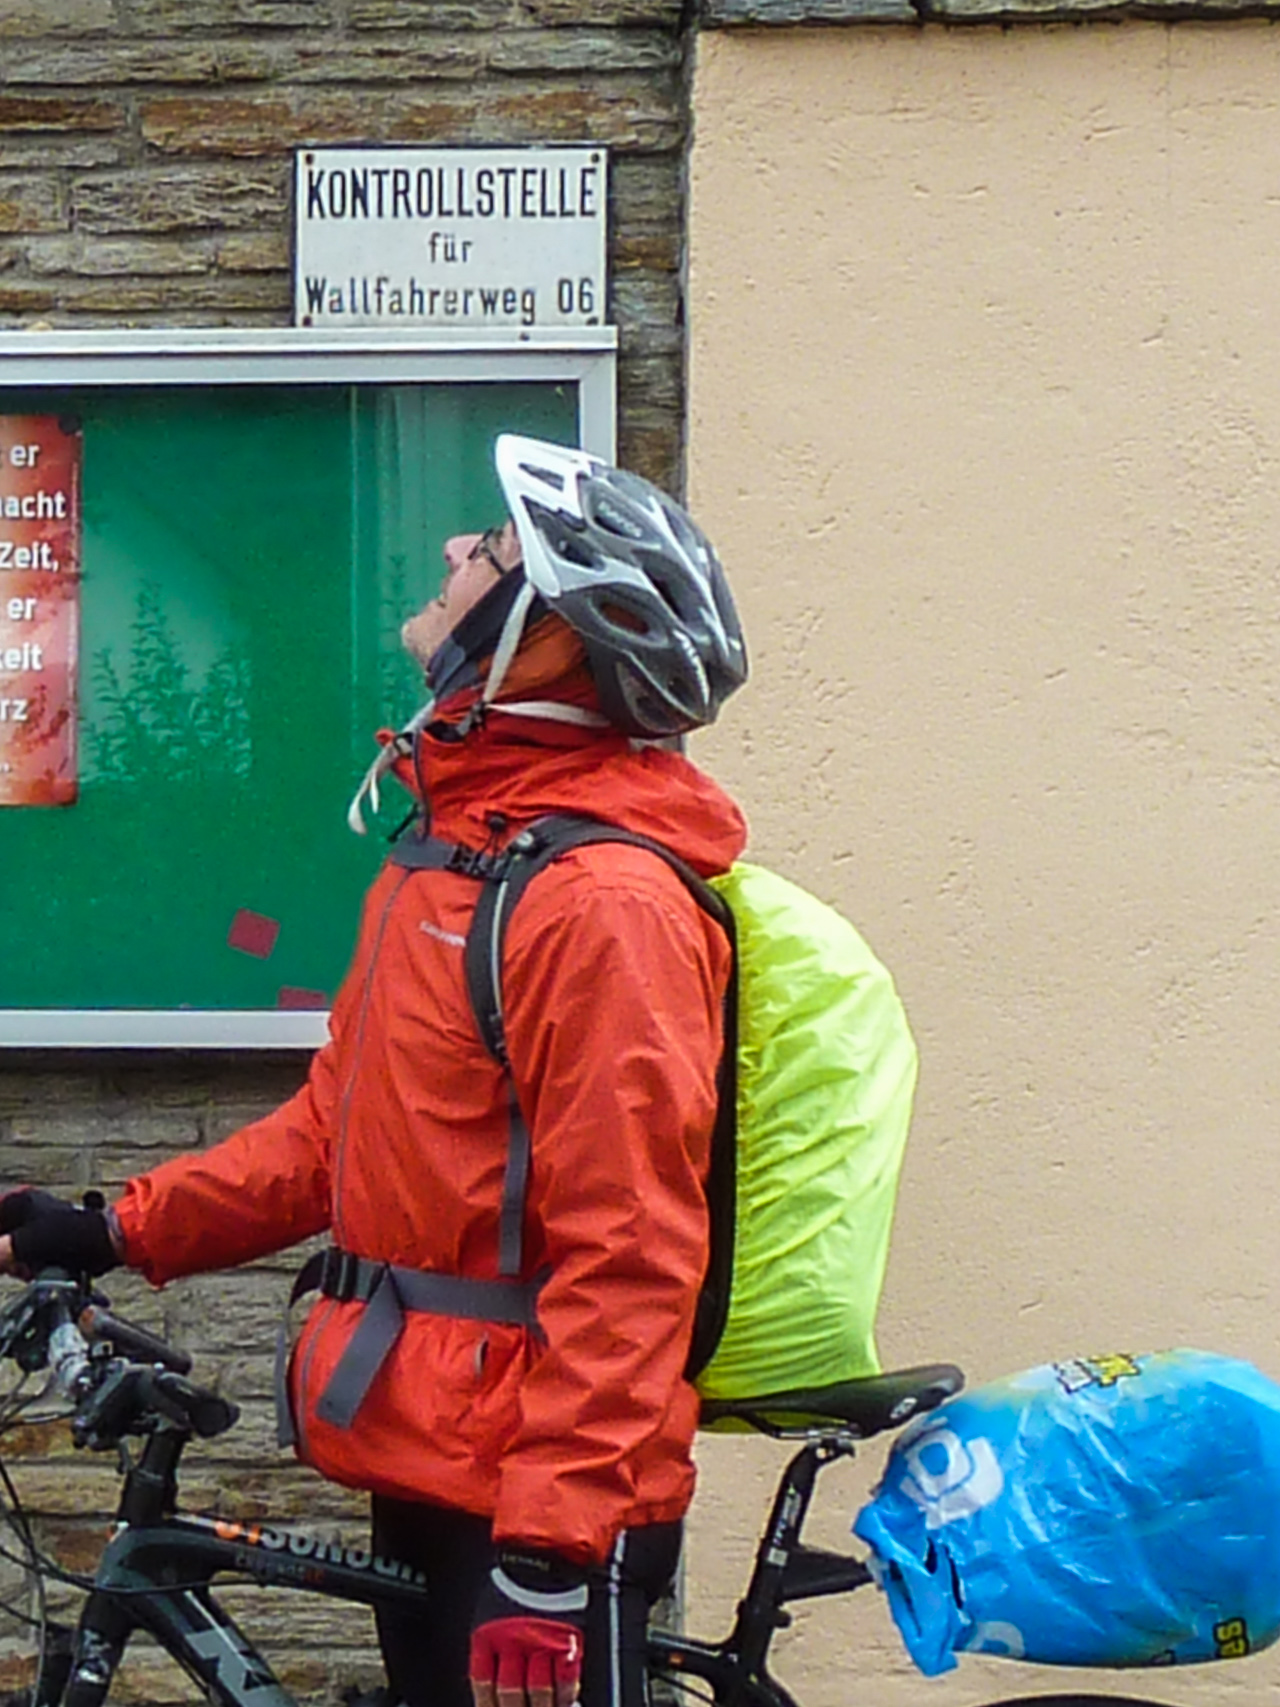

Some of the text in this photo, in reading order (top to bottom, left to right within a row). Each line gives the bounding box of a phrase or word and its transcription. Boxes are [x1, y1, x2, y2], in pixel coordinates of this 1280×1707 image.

[306, 166, 598, 219] KONTROLLSTELLE
[428, 231, 473, 263] für
[305, 276, 595, 326] Wallfahrerweg 06
[9, 444, 40, 466] er
[6, 596, 37, 619] er
